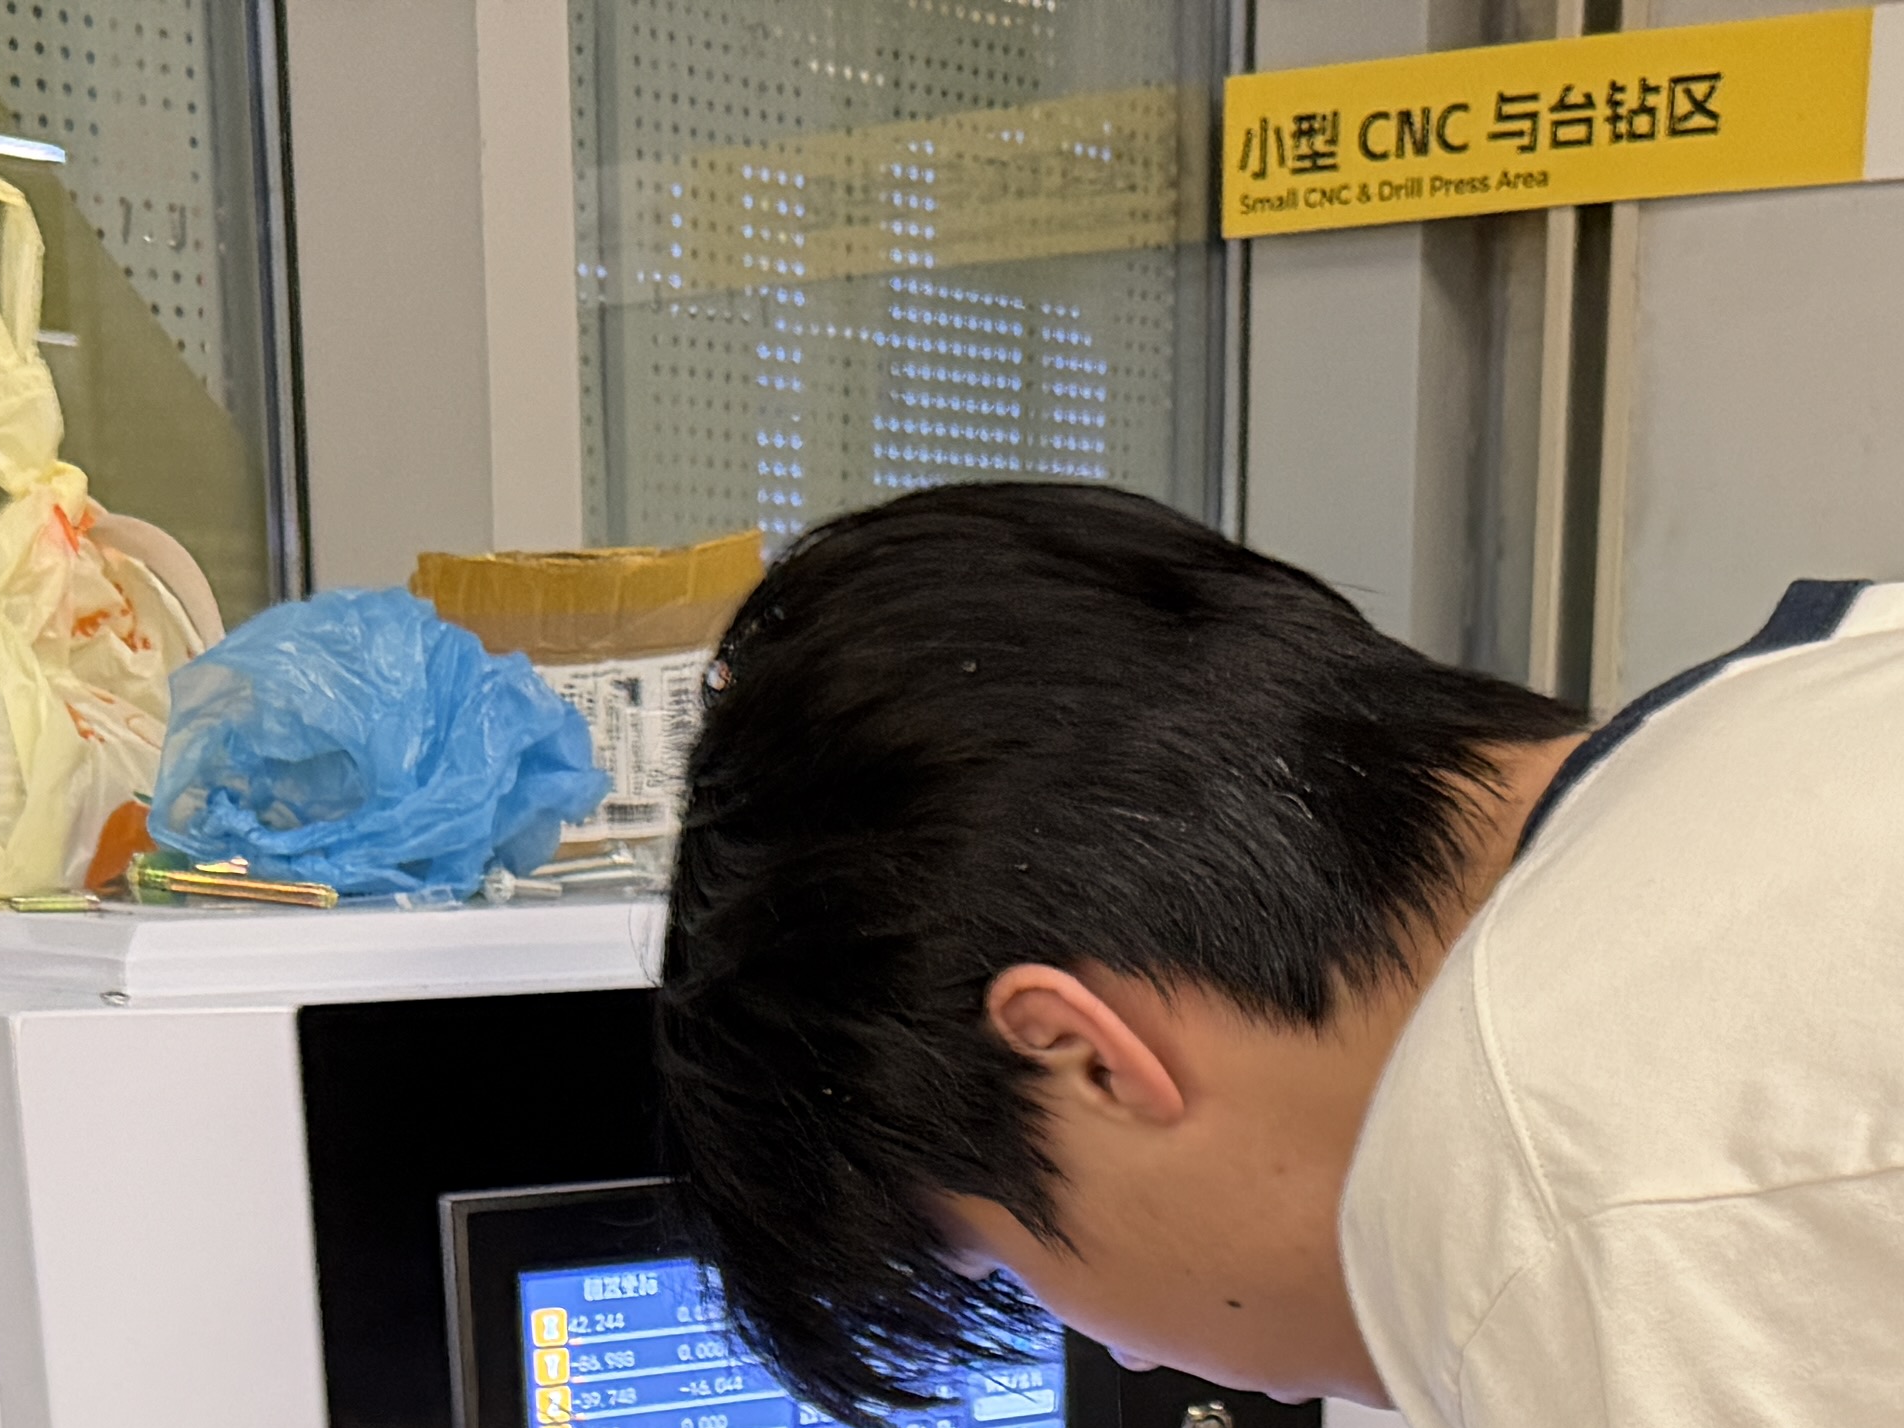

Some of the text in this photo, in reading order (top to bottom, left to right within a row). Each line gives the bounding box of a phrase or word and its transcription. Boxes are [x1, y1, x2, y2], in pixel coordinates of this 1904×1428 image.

[1238, 72, 1722, 180] 小型 CNC 与台钻区
[1240, 171, 1549, 215] Small CNC & Drill Press Area
